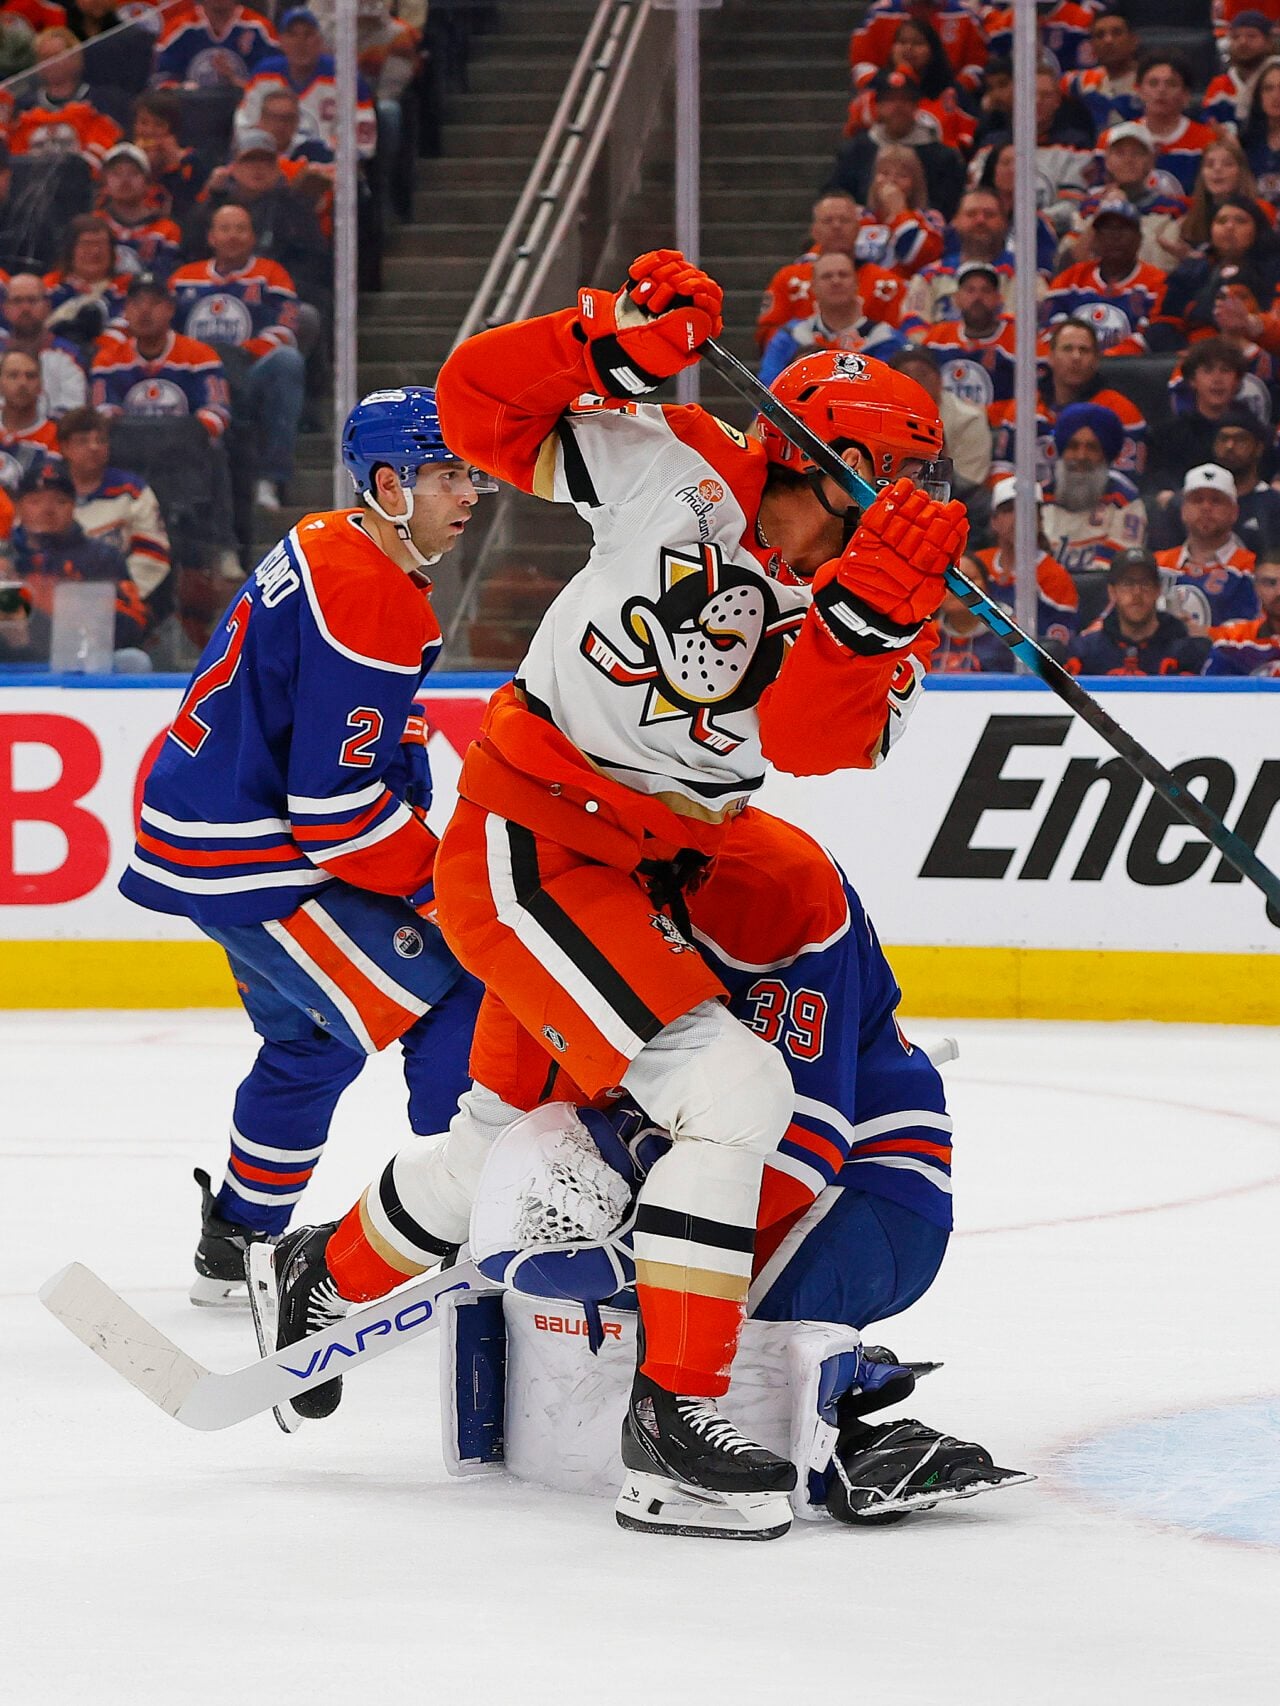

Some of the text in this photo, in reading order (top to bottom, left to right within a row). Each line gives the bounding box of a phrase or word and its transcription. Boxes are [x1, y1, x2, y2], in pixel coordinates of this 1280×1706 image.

[581, 294, 594, 319] 25
[686, 321, 695, 351] TRUE
[675, 486, 714, 541] Anaheim
[338, 705, 384, 768] 2
[740, 978, 829, 1063] 39
